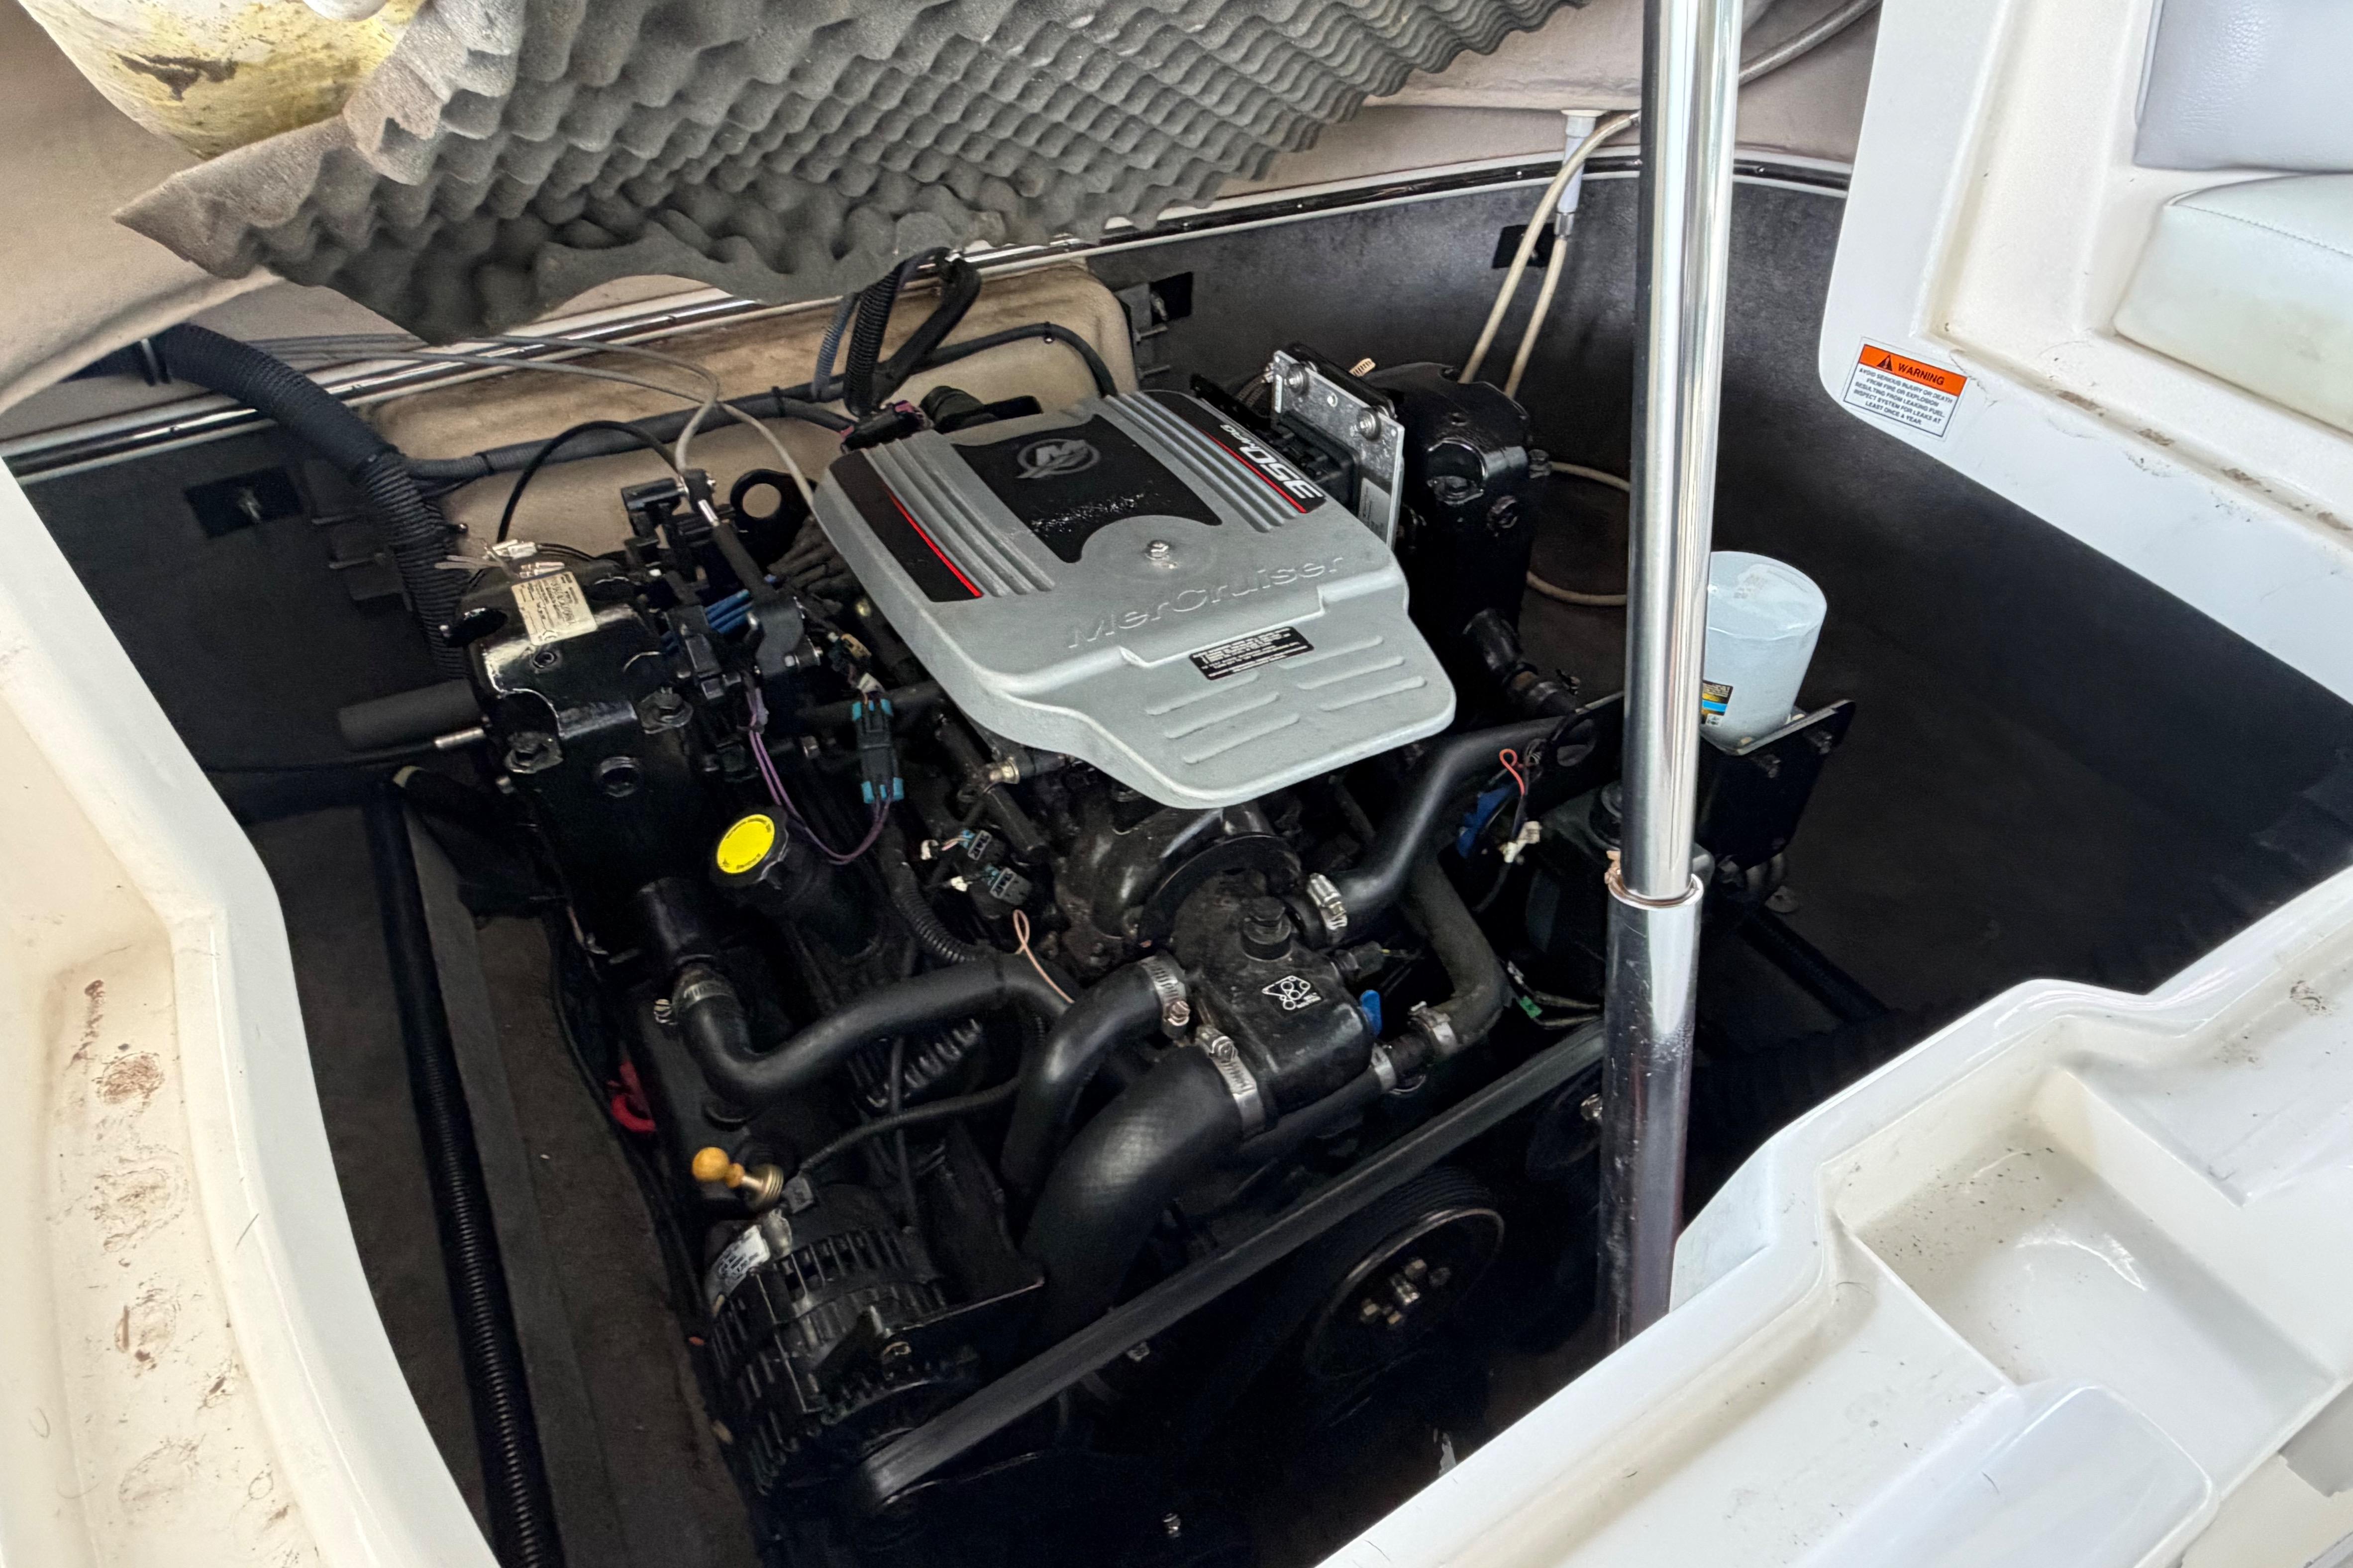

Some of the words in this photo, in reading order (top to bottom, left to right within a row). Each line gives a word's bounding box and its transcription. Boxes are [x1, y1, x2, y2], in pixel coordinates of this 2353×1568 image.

[1859, 368, 1875, 377] AVOID
[1877, 374, 1901, 385] SERIOUS
[1902, 383, 1922, 392] INJURY
[1933, 393, 1952, 403] DEATH
[1898, 363, 1944, 385] WARNING
[1854, 389, 1876, 400] INSPECT
[1877, 397, 1900, 408] SYSTEM
[1913, 410, 1932, 420] LEAKS
[1855, 382, 1885, 395] RESULTING
[1886, 393, 1902, 401] FROM
[1903, 398, 1928, 410] LEAKING
[1866, 378, 1882, 387] FROM
[1906, 392, 1939, 406] EXPLOSION
[1865, 401, 1882, 410] LEAST
[1884, 407, 1899, 416] ONCE
[1239, 446, 1324, 498] 350
[1068, 557, 1344, 648] MerCruiser
